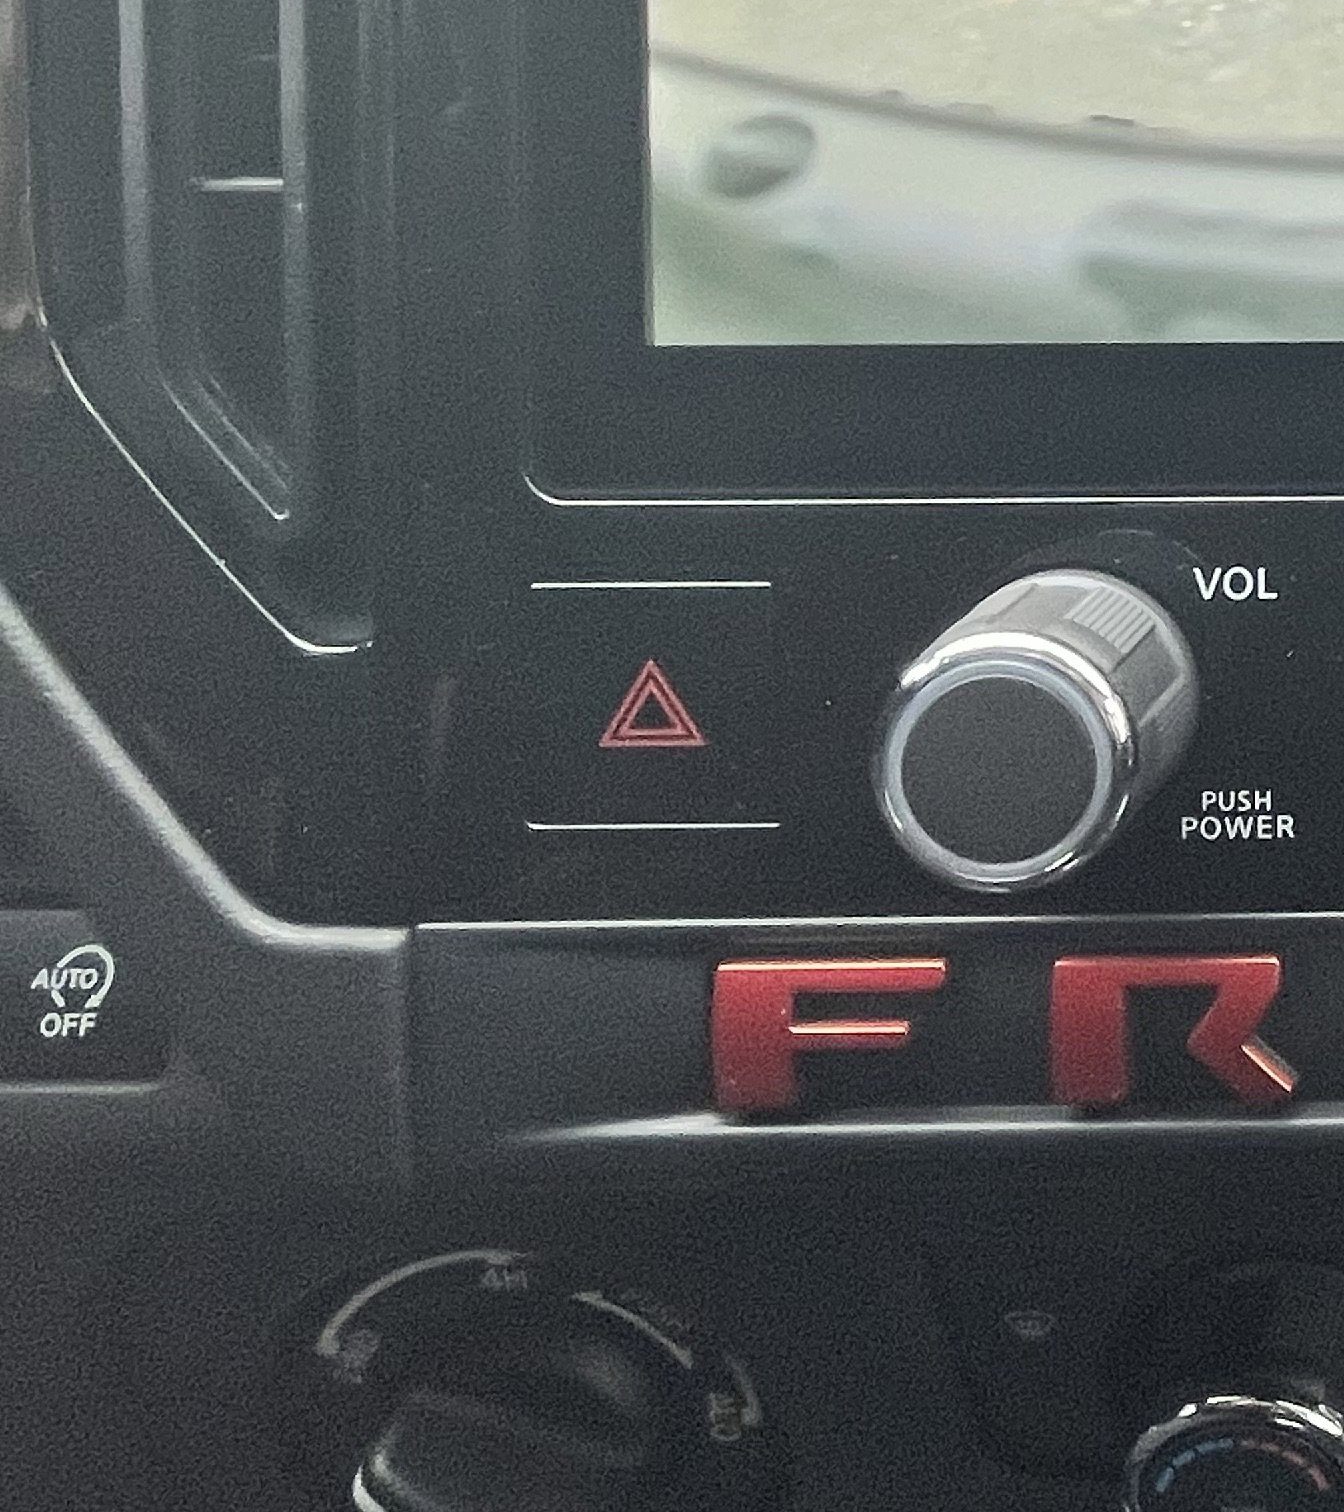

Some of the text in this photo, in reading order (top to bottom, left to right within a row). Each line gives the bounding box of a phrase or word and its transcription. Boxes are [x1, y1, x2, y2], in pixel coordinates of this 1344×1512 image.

[1192, 566, 1278, 601] VOL
[1202, 790, 1273, 812] PUSH
[1181, 814, 1295, 840] POWER
[30, 968, 99, 991] AUTO
[40, 1012, 98, 1038] OFF
